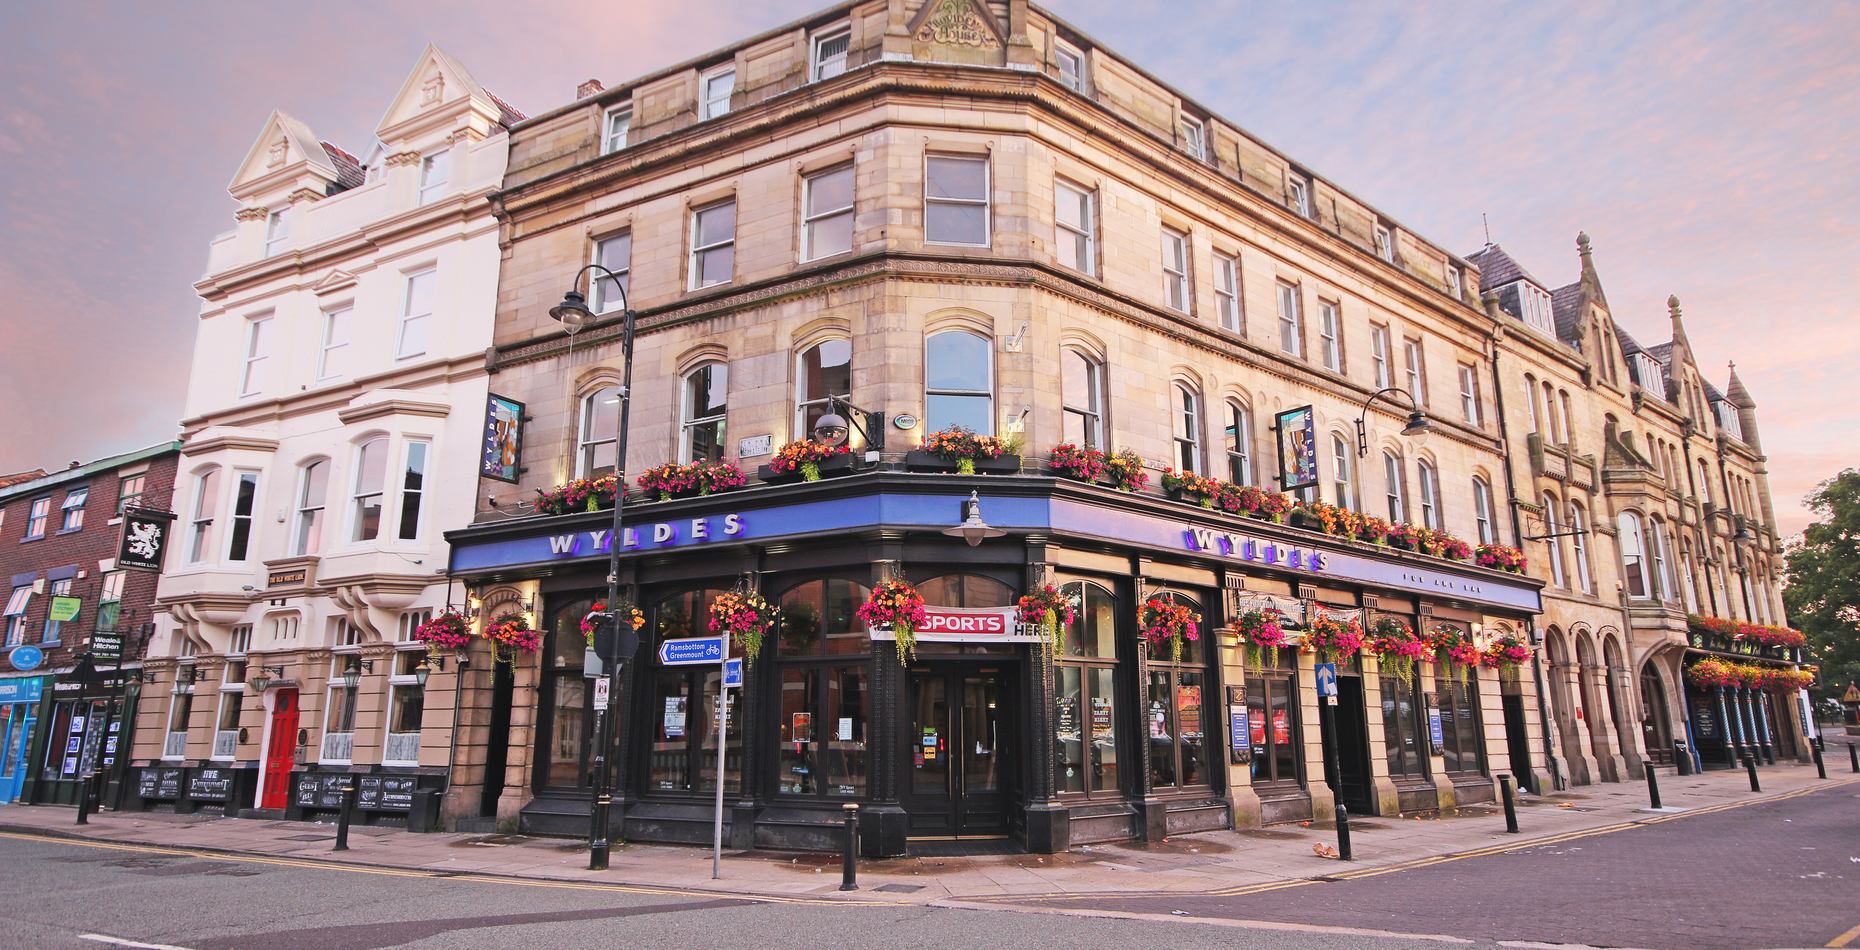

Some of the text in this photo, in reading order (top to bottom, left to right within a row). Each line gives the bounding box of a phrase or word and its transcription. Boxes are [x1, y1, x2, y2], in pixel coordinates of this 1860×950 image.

[485, 399, 497, 470] WYLDES
[1305, 411, 1316, 480] WYLDES
[550, 514, 743, 554] WYLDES
[1190, 528, 1329, 570] WYLDES
[919, 615, 1001, 632] SPORTS
[670, 651, 704, 659] Greenmount
[671, 643, 705, 651] Ramsbottom
